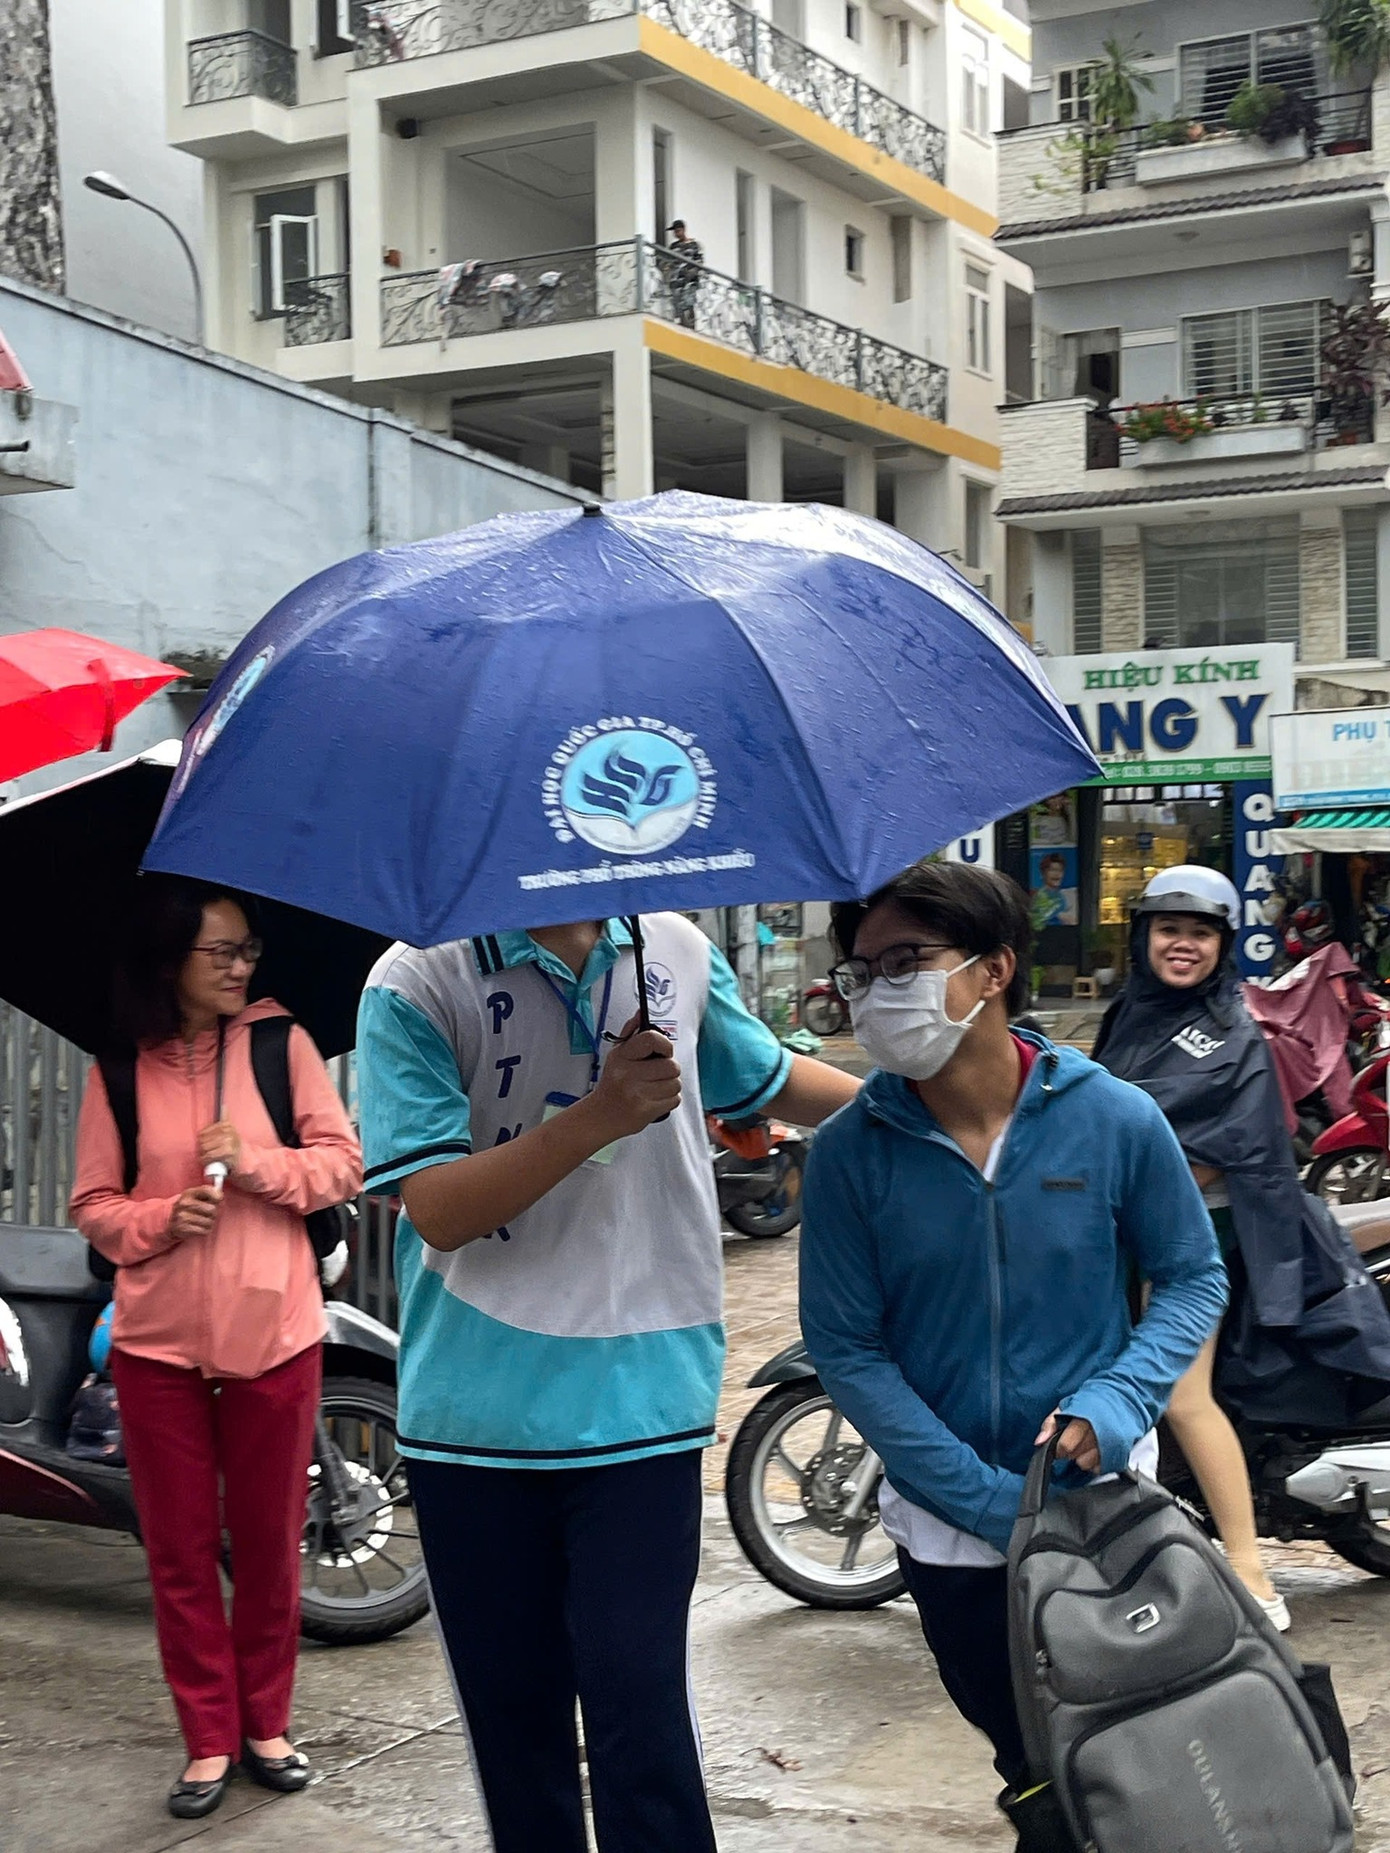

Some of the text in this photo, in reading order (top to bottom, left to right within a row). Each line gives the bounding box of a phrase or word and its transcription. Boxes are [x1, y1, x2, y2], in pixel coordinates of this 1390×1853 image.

[1083, 656, 1260, 692] HIỆU KÍNH
[1218, 693, 1271, 748] Y
[1332, 721, 1377, 743] PHỤ
